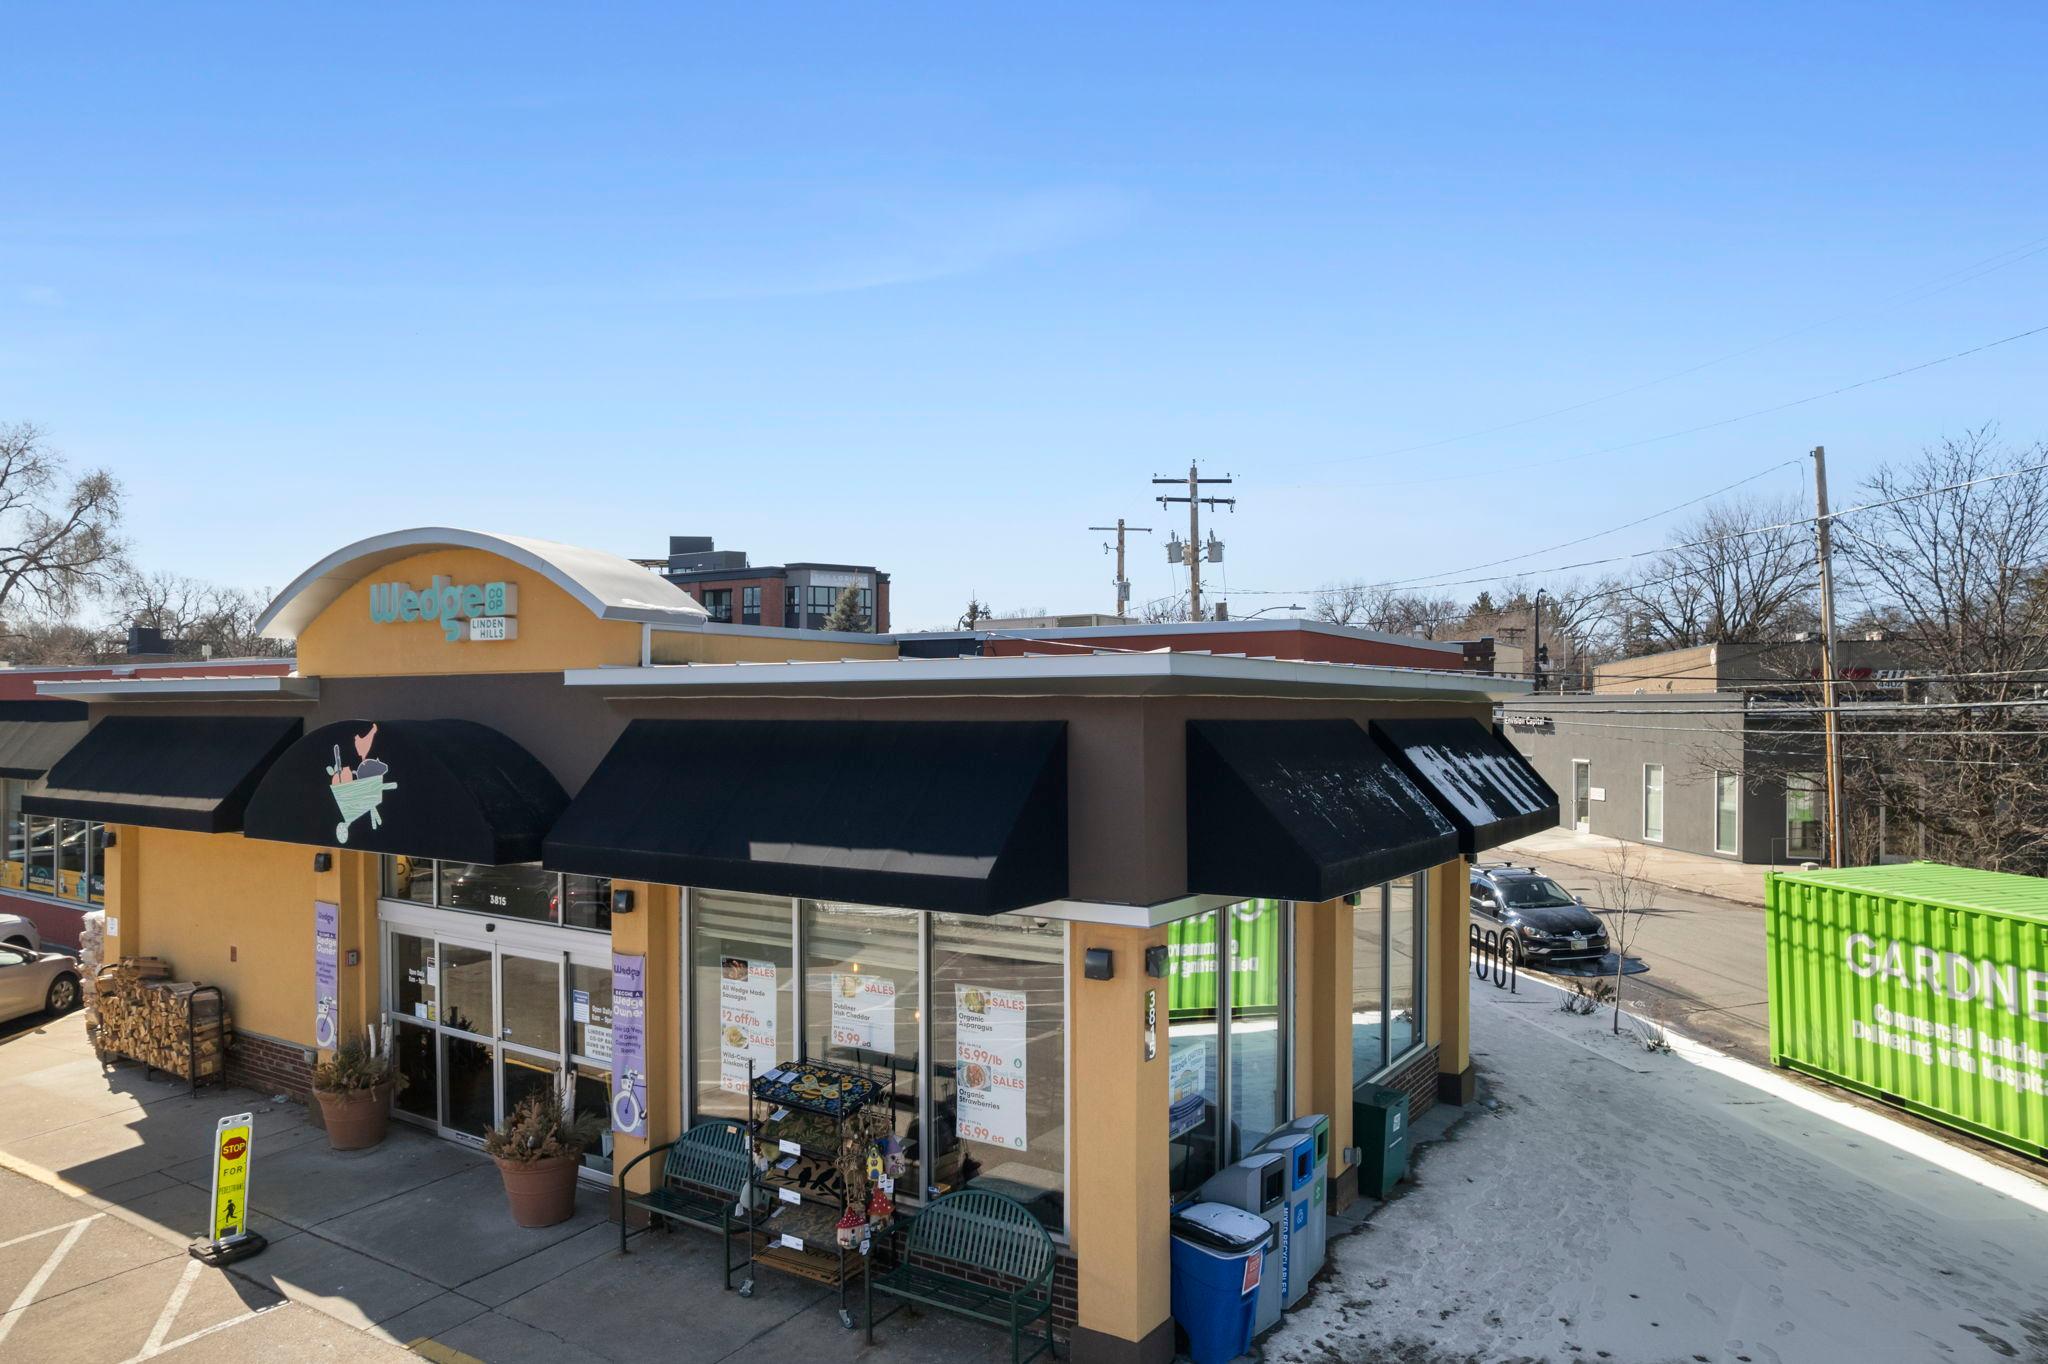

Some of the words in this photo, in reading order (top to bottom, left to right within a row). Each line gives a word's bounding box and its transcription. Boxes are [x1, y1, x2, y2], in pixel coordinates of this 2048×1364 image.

[488, 588, 503, 598] CO
[370, 575, 482, 641] Wedge
[488, 600, 503, 610] OP
[472, 619, 504, 629] LINDEN
[480, 630, 504, 638] HILLS
[490, 895, 507, 906] 3815
[613, 964, 641, 981] Wedge
[748, 967, 775, 978] SALES
[864, 984, 894, 996] SALES
[834, 1002, 857, 1012] Dubliner
[992, 997, 1025, 1011] SALES
[846, 1012, 871, 1021] Cheddar
[958, 1012, 985, 1023] Organic
[958, 1021, 993, 1032] Asparagus
[1148, 990, 1157, 1059] 3815
[1874, 1002, 1974, 1049] Commercial
[750, 1035, 775, 1047] SALES
[833, 1030, 860, 1046] $5.99
[1852, 1018, 1935, 1066] Delivering
[1937, 1046, 1977, 1074] with
[958, 1046, 1003, 1066] $5.99/lb
[992, 1074, 1025, 1089] SALES
[958, 1088, 985, 1099] Organic
[958, 1095, 1000, 1110] Strawberries
[958, 1122, 989, 1140] $5.99
[992, 1135, 1005, 1144] ea
[223, 1142, 246, 1154] STOP
[224, 1165, 243, 1176] FOR
[1281, 1234, 1290, 1294] RECYCLABLES
